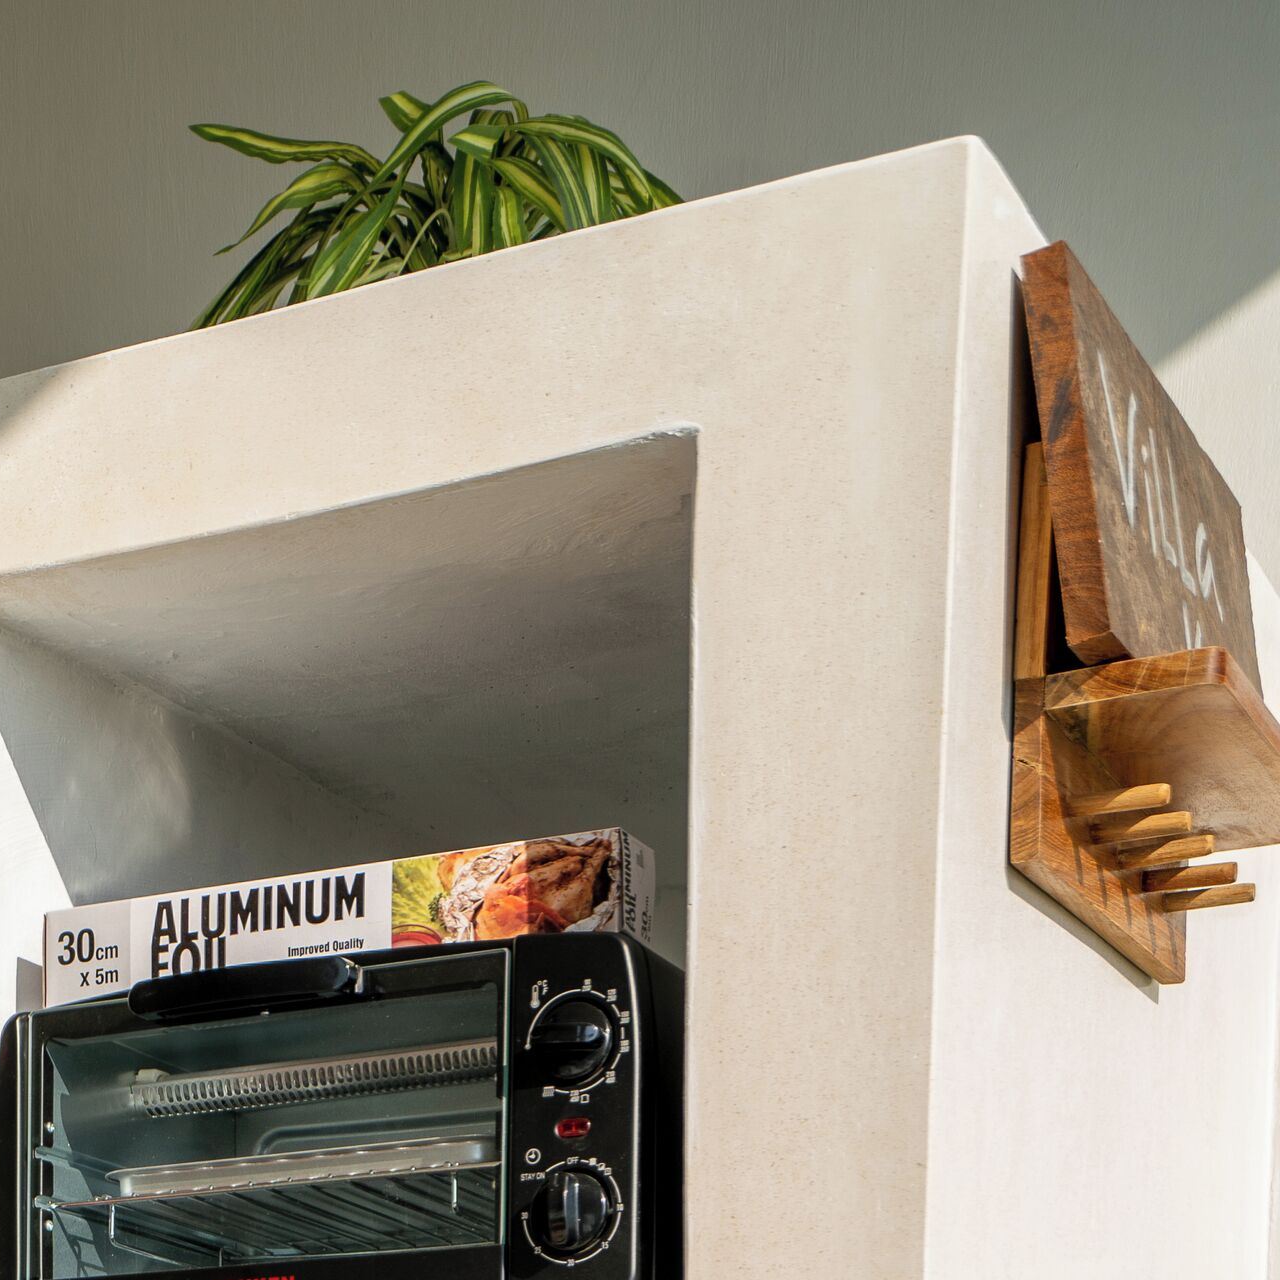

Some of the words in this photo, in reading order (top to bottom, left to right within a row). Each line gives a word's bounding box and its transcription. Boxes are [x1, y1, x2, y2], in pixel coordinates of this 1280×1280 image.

[1097, 349, 1224, 624] Villa
[151, 871, 366, 944] ALUMINUM
[57, 927, 119, 966] 30cm
[287, 942, 330, 958] Improved
[332, 937, 365, 955] Quality
[95, 968, 119, 985] 5m
[566, 1156, 580, 1164] OFF
[520, 1173, 536, 1181] STAY
[536, 1172, 546, 1180] ON
